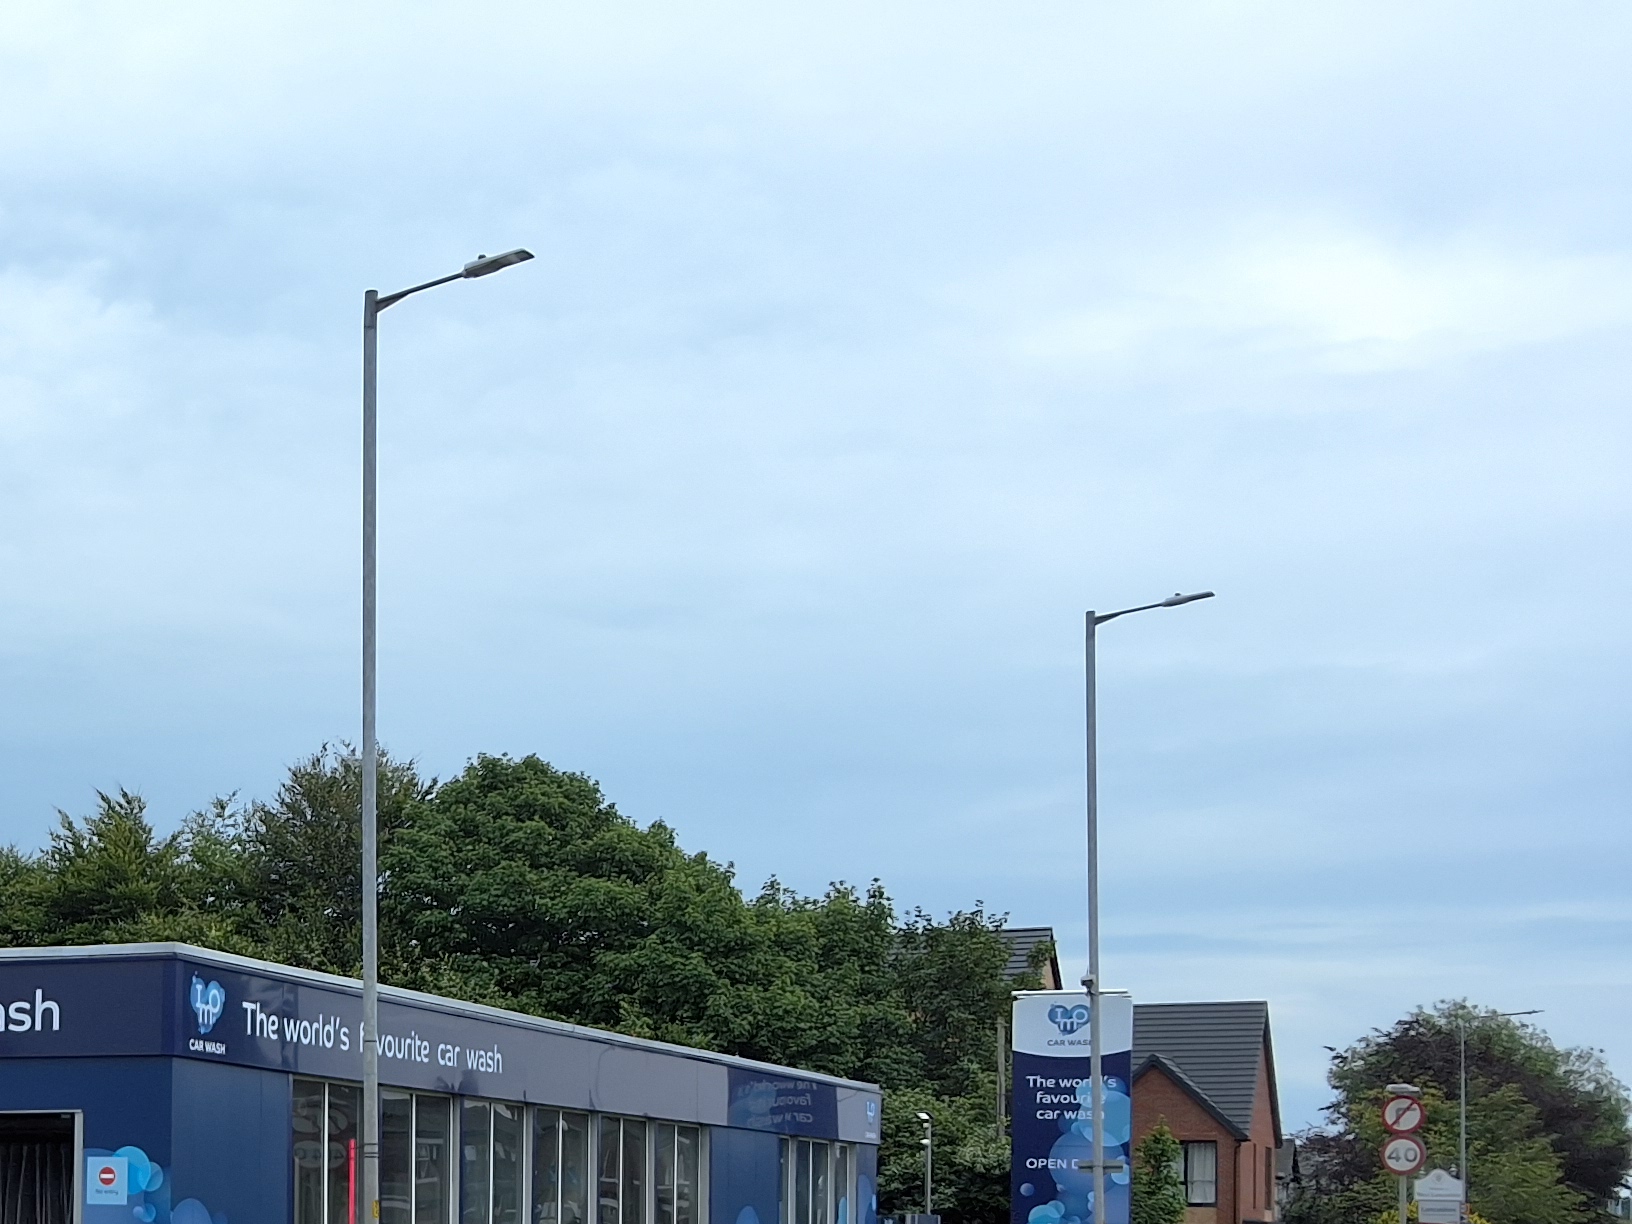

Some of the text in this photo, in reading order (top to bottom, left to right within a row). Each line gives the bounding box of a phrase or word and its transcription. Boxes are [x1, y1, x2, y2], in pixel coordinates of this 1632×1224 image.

[242, 1001, 504, 1074] The world's fvourite car wash
[189, 1038, 226, 1055] CAR WASH
[1025, 1075, 1055, 1088] The
[1036, 1091, 1106, 1104] favouri
[1036, 1110, 1059, 1120] car
[1387, 1147, 1418, 1163] 40
[1025, 1158, 1067, 1169] OPEN
